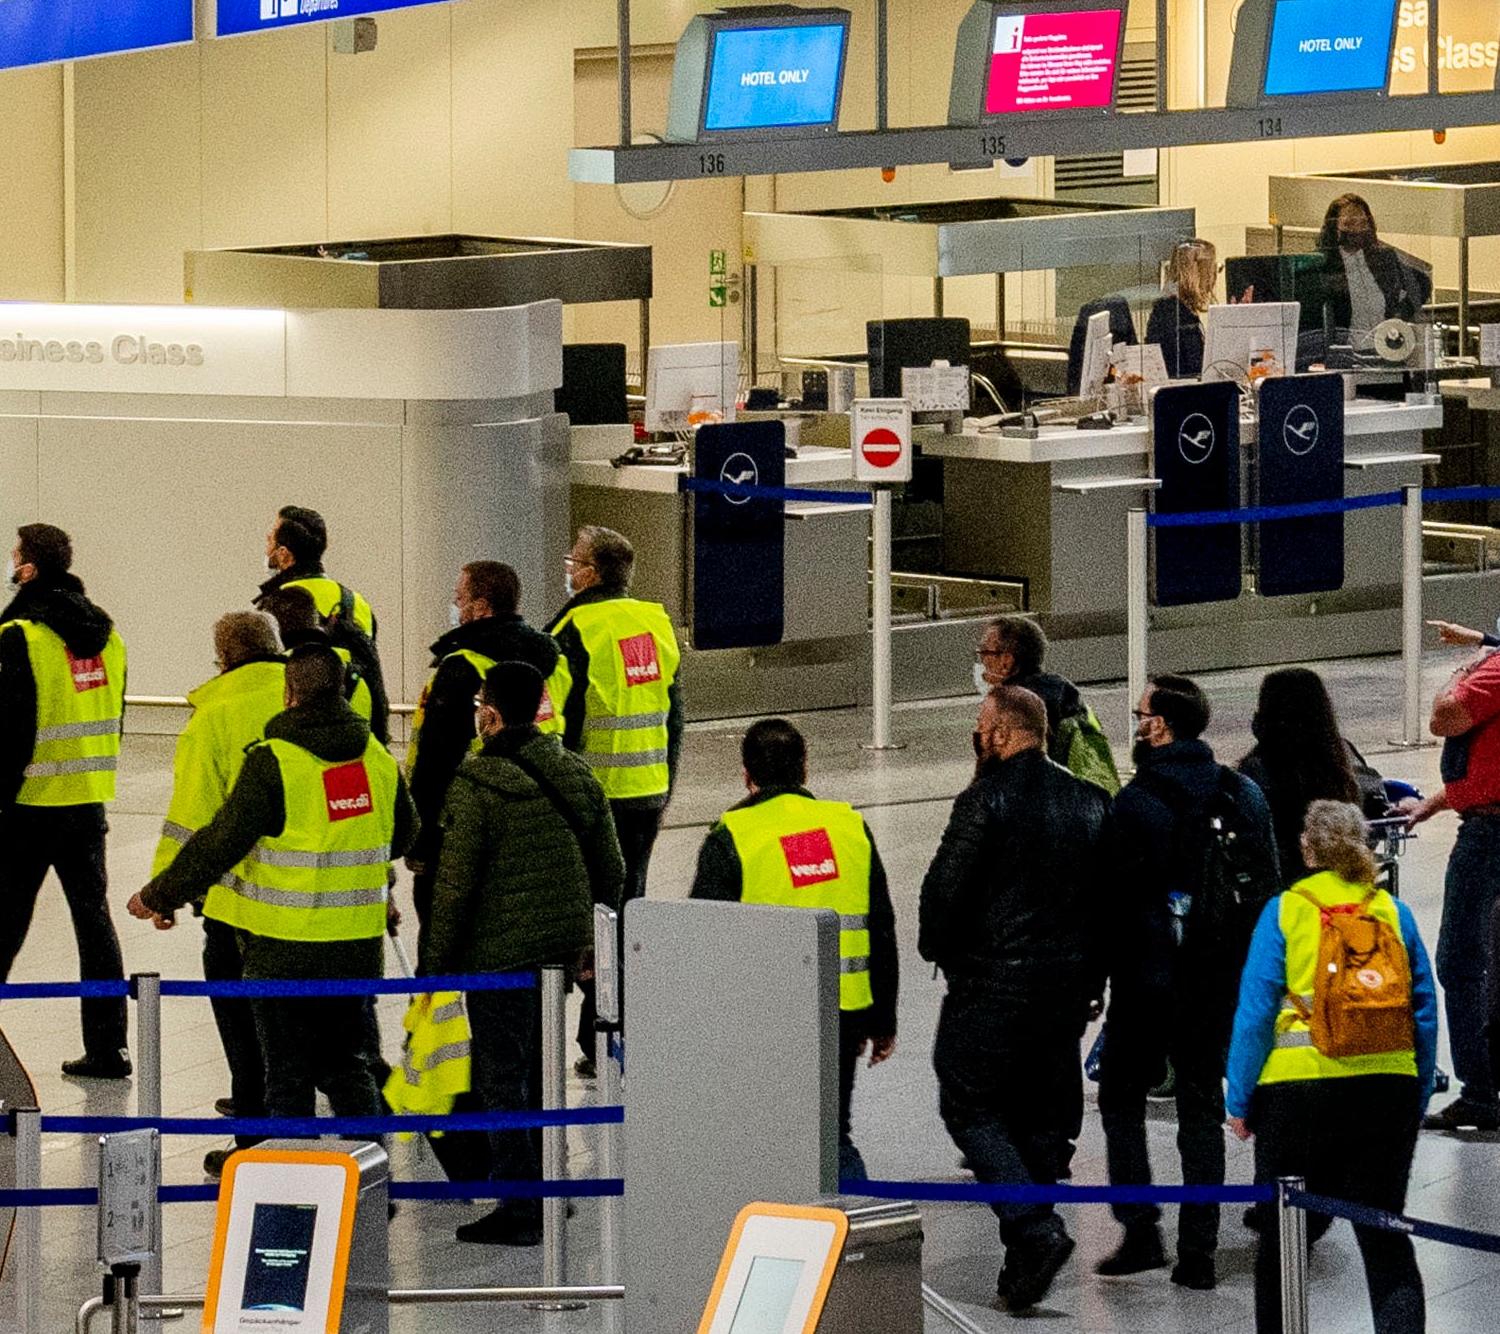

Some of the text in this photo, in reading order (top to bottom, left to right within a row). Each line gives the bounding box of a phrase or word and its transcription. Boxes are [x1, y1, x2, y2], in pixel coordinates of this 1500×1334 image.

[1298, 36, 1363, 53] HOTEL ONLY
[740, 68, 810, 88] HOTEL ONLY
[1258, 117, 1282, 138] 134
[979, 135, 1006, 157] 135
[698, 152, 725, 176] 136
[111, 332, 205, 366] Class
[328, 792, 371, 811] ver.di
[789, 857, 837, 878] ver.di
